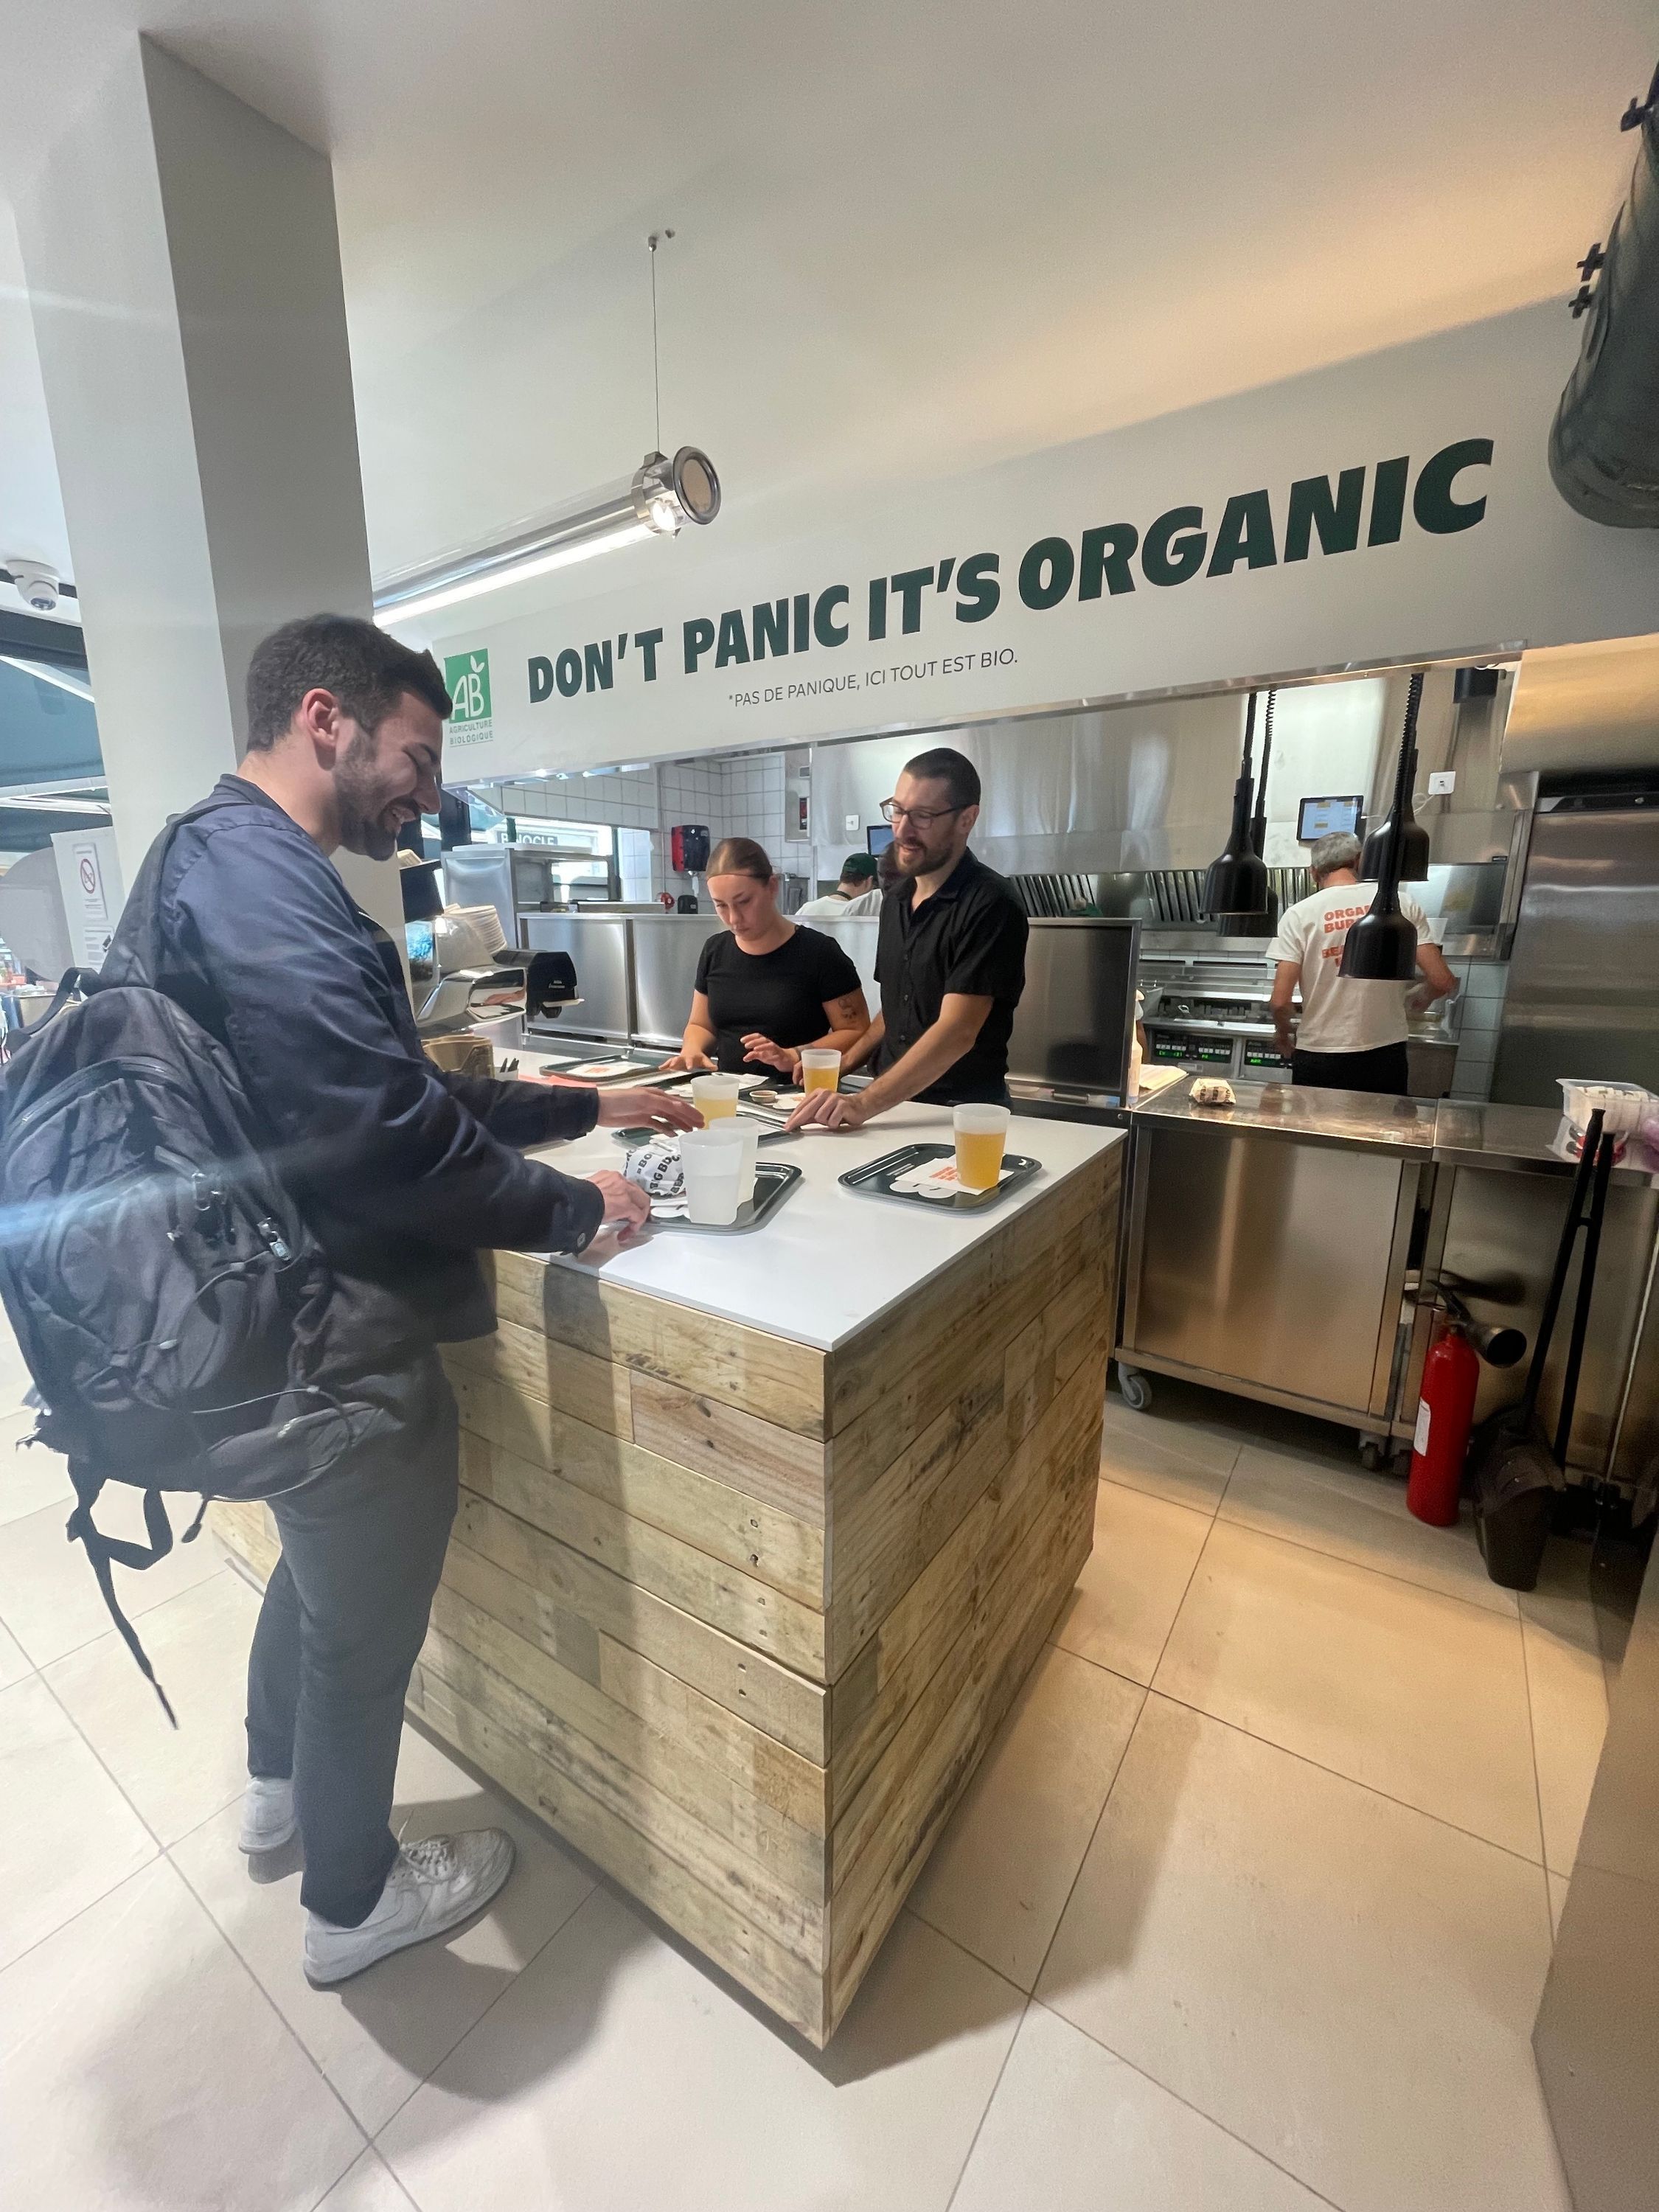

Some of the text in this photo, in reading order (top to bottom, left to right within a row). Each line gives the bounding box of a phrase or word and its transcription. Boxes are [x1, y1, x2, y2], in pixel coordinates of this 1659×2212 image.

[529, 438, 1495, 703] DON'T PANIC IT'S ORGANIC
[451, 673, 484, 720] AB
[764, 686, 784, 703] DE
[787, 674, 861, 699] PANIQUE,
[866, 669, 886, 687] ICI
[890, 660, 938, 682] TOUT
[942, 654, 976, 675] EST
[981, 648, 1018, 669] BIO.
[449, 720, 493, 734] AGRICULTURE
[450, 731, 493, 745] BIOLOGIQUE
